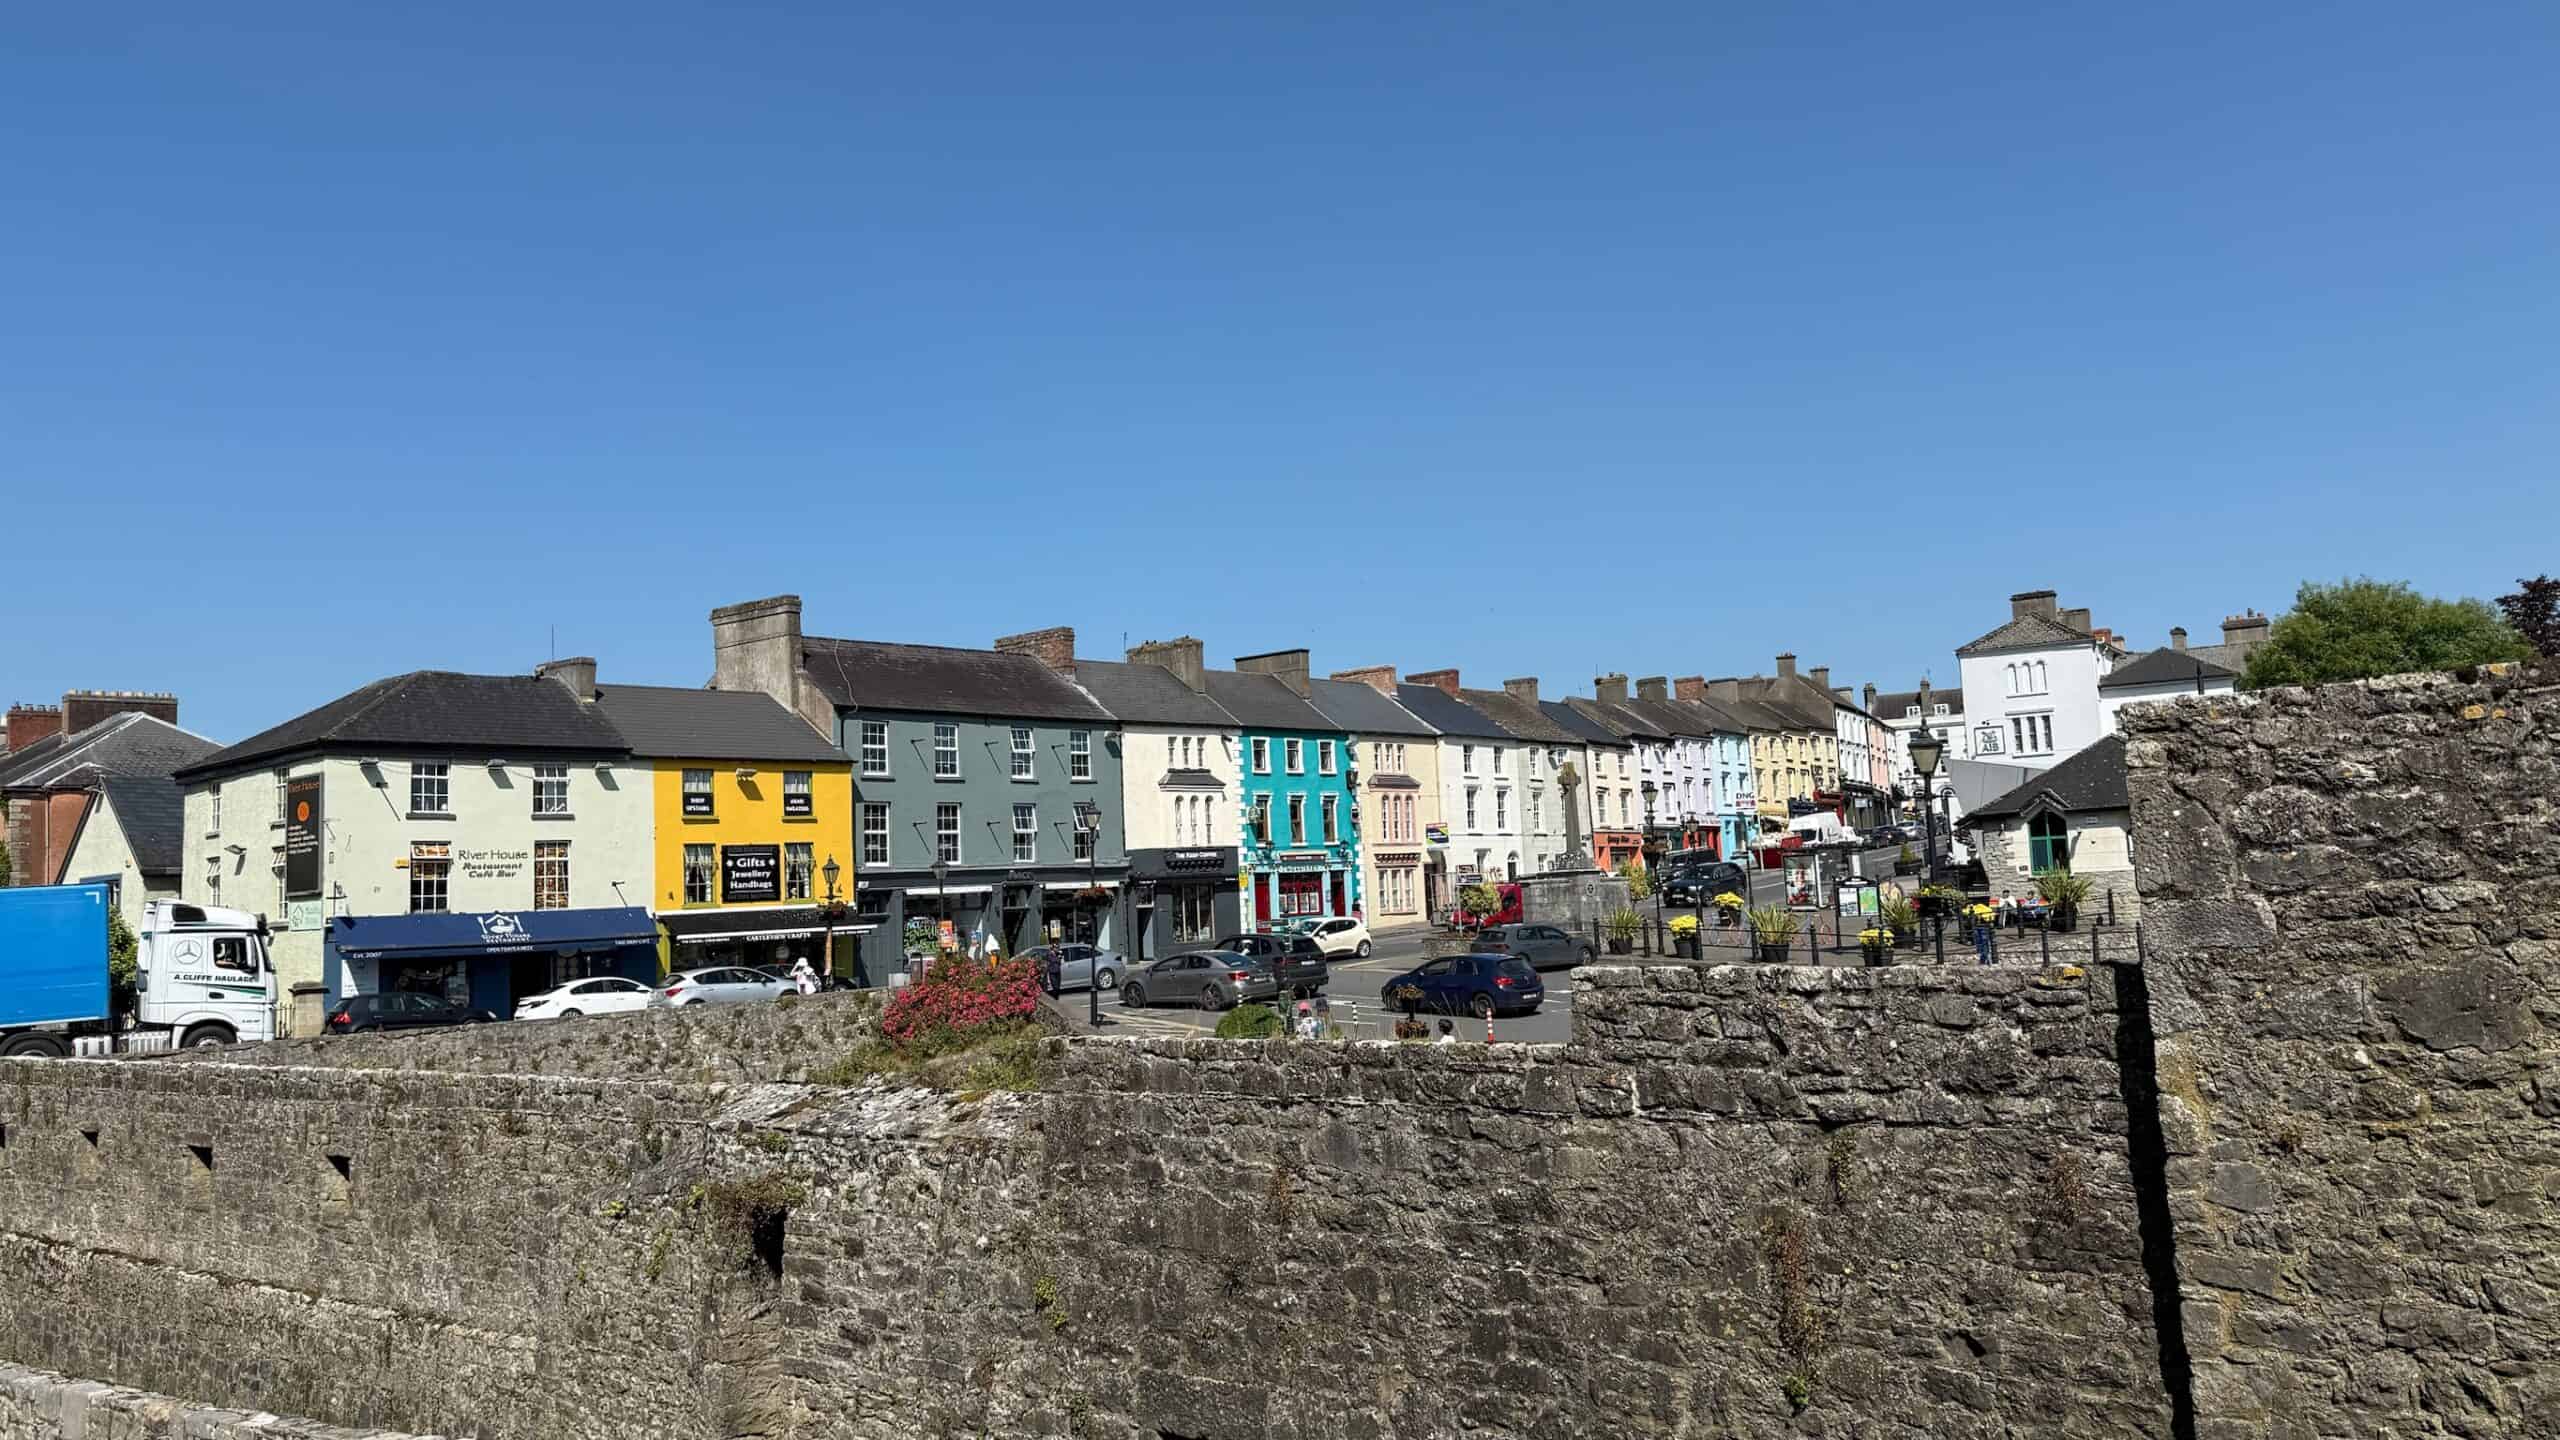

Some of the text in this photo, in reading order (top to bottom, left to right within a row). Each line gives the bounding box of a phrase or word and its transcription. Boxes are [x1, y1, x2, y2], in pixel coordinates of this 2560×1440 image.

[1982, 743, 2000, 752] AIB
[458, 849, 528, 860] River House
[463, 862, 522, 870] Restaurant
[736, 856, 766, 867] Gifts
[495, 869, 516, 877] Bar
[731, 869, 771, 879] Jewellery
[730, 880, 773, 889] Handbags
[787, 932, 811, 940] CRAFTS
